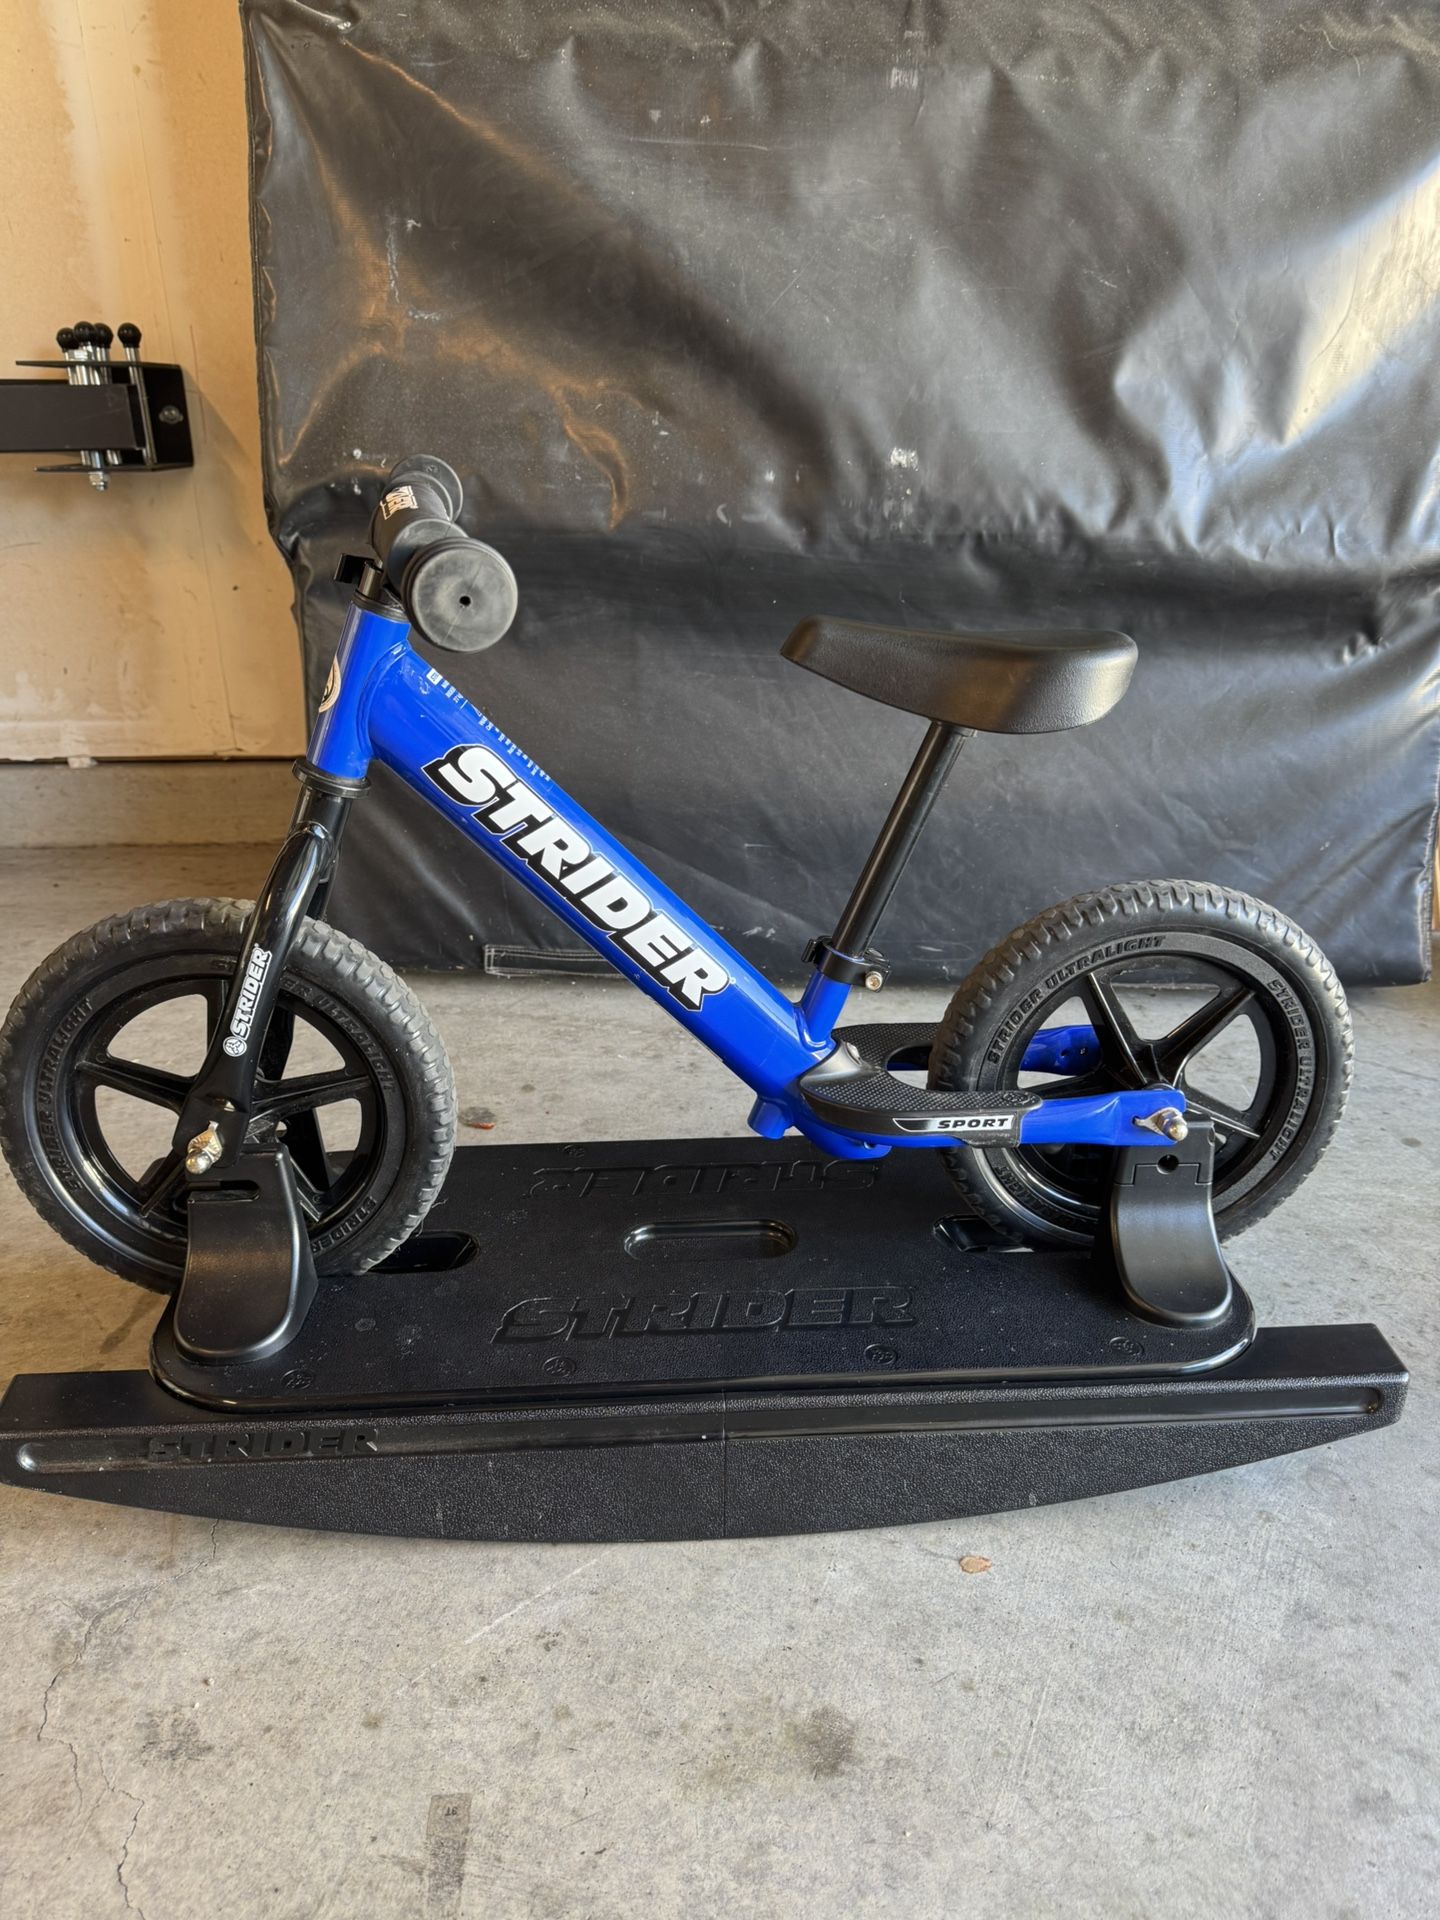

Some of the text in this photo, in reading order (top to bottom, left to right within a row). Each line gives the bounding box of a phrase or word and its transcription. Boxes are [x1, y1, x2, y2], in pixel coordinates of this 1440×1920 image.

[421, 743, 732, 1012] STRIDER
[229, 946, 273, 1040] STRIDER
[987, 935, 1167, 1065] STRIDER ULTRALIGHT
[1267, 978, 1313, 1162] STRIDER ULTRALIGHT
[937, 1117, 1009, 1130] SPORT
[489, 1285, 919, 1344] STRIDER
[146, 1427, 379, 1462] STRIDER
